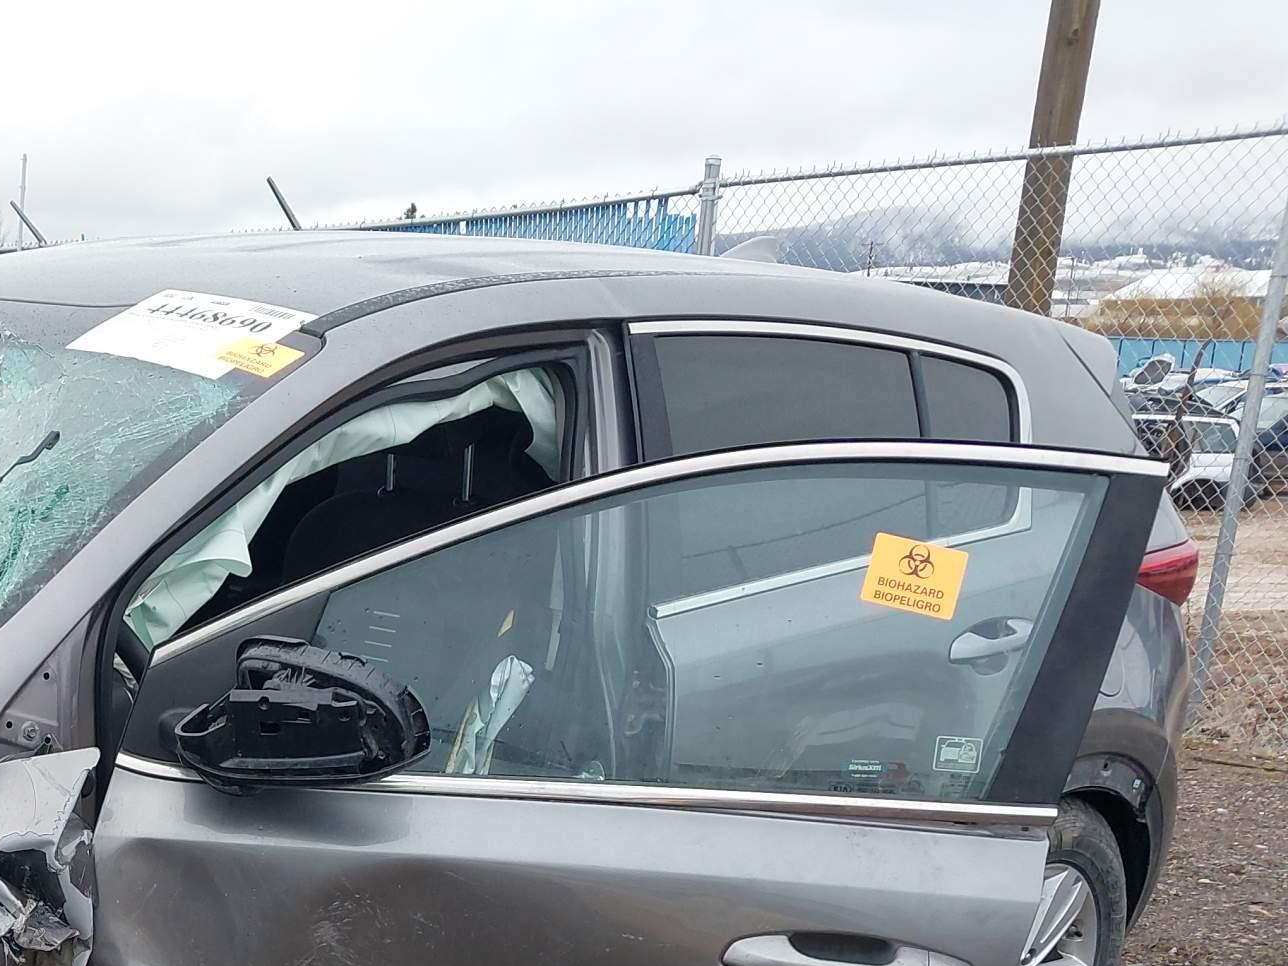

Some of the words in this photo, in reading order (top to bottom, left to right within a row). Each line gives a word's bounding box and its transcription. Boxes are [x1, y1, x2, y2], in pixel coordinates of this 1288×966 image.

[147, 303, 272, 333] 44468690
[877, 576, 944, 599] BIOHAZARD
[873, 590, 941, 613] BIOPELIGRO
